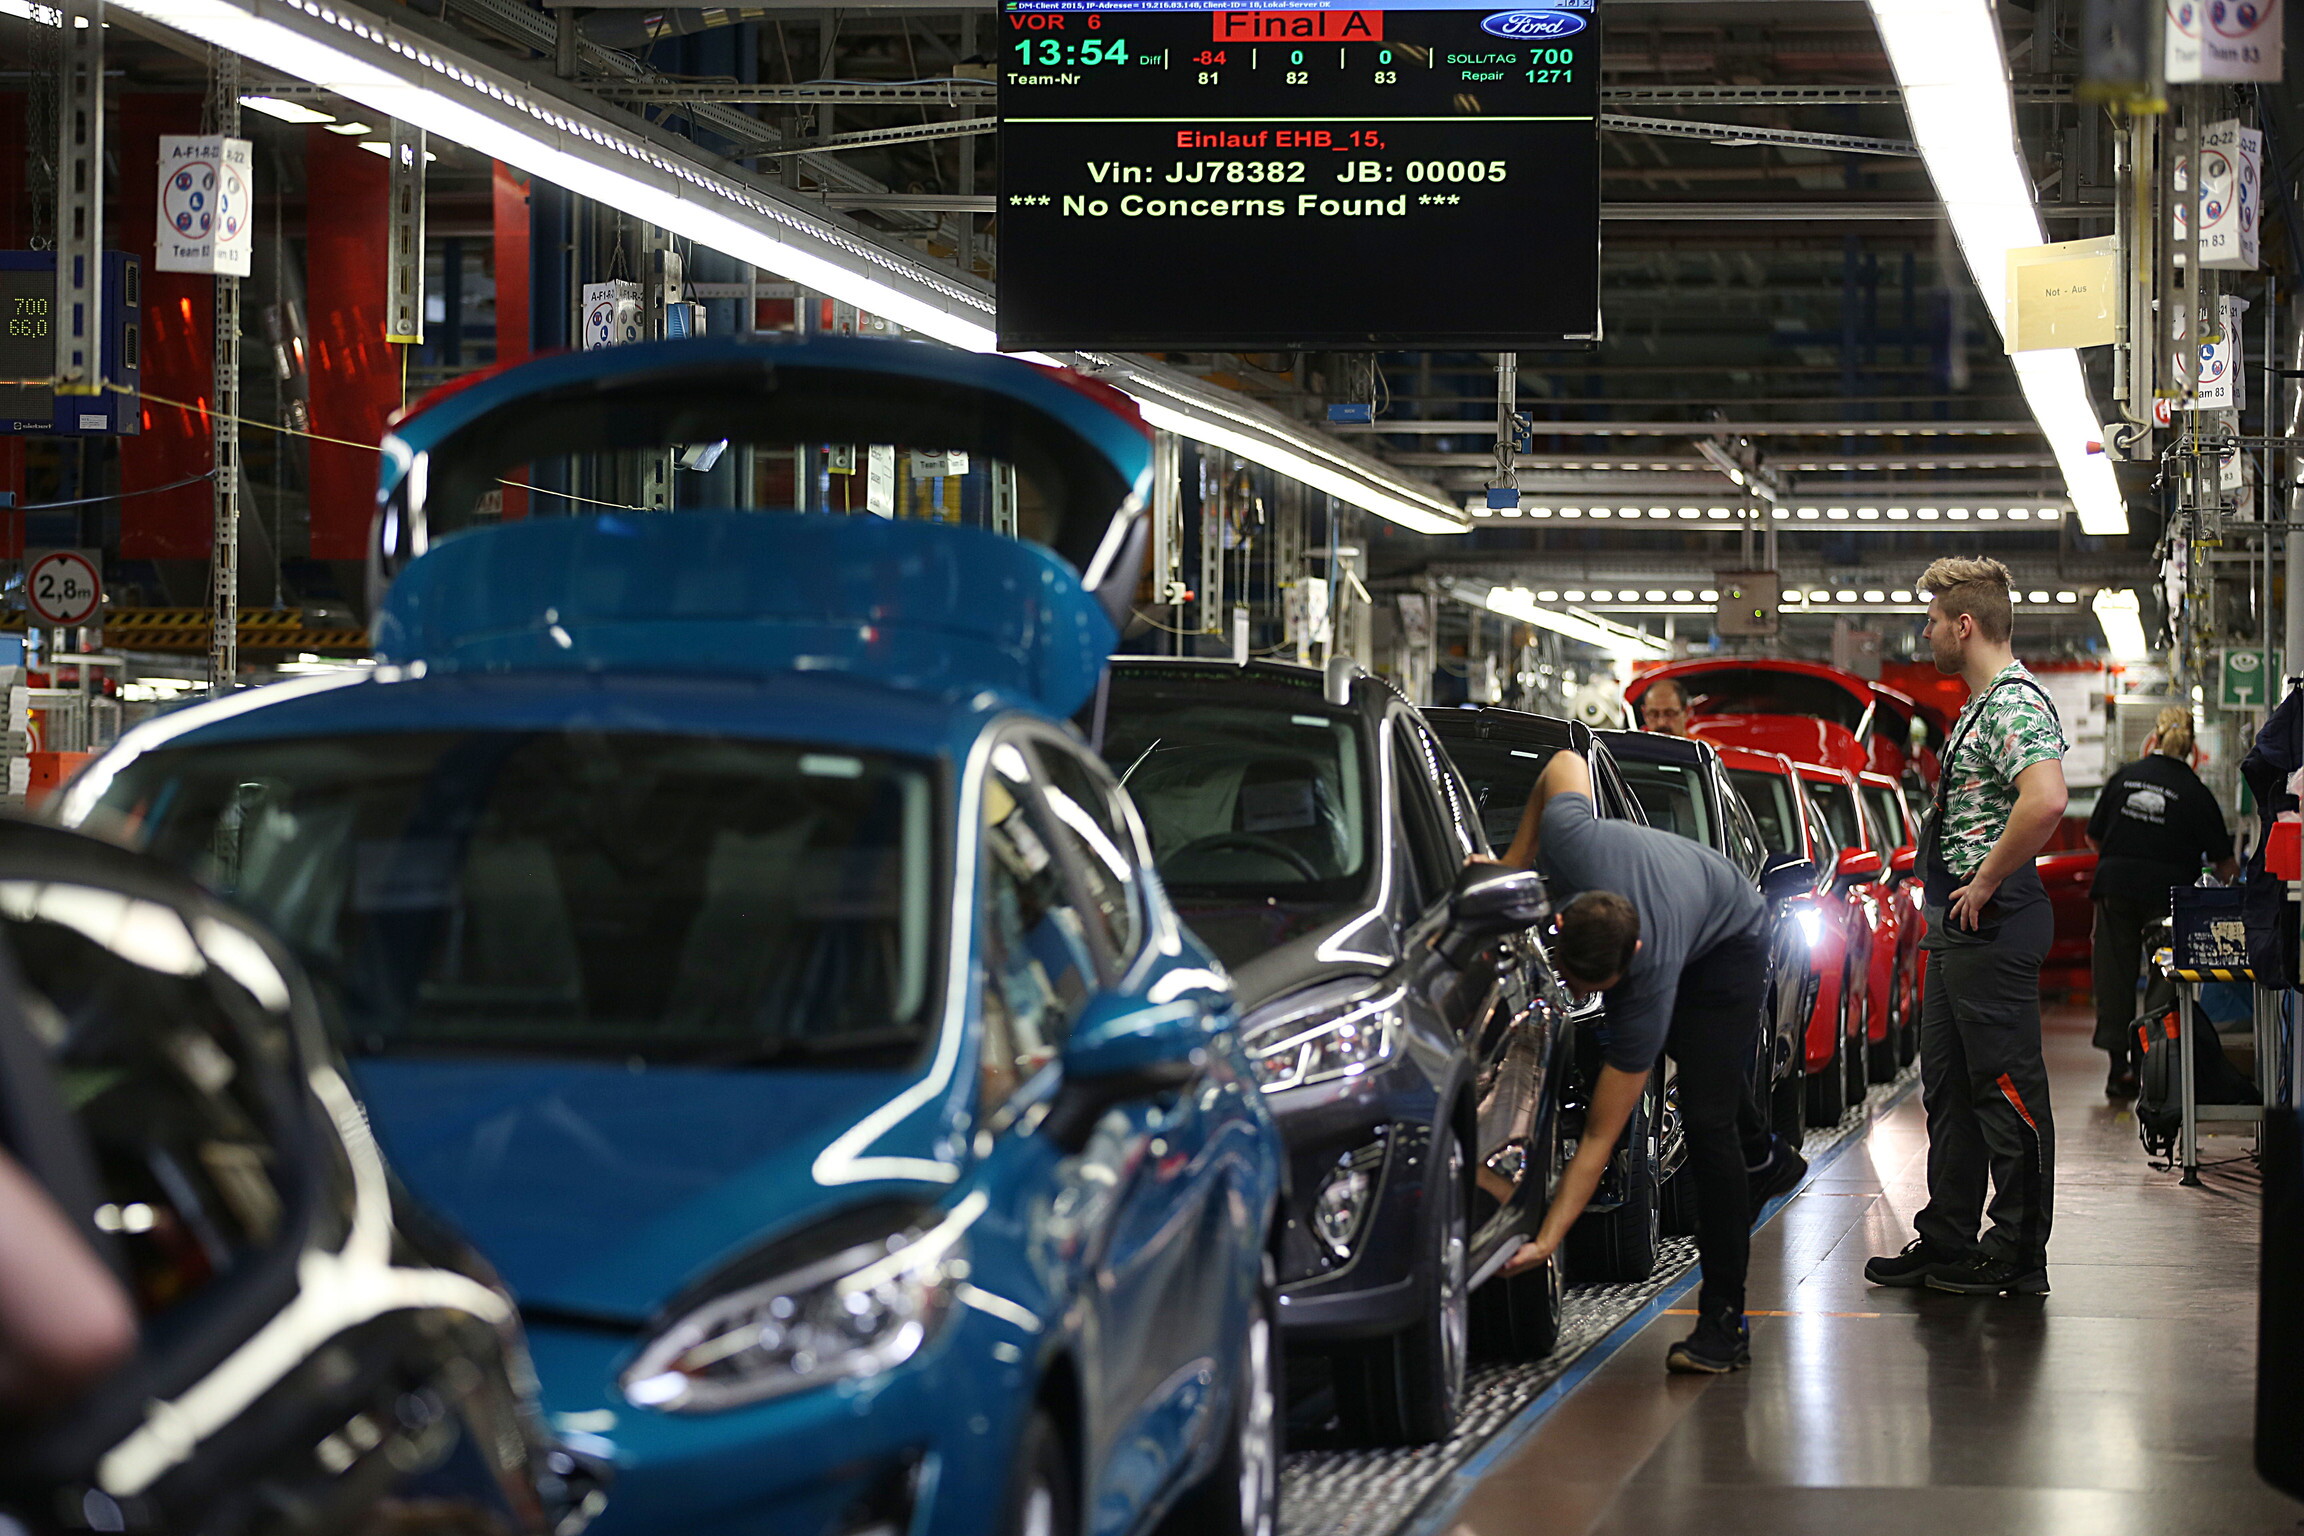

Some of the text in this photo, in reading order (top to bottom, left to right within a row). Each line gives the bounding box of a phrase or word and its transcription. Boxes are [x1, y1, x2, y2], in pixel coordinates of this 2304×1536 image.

[1061, 2, 1084, 10] 2015,
[1009, 14, 1101, 30] VOR 6
[1225, 11, 1371, 37] Final A
[1502, 13, 1565, 34] Ford
[1015, 38, 1129, 66] 13:54
[1139, 49, 1392, 65] Diff -84 0 0
[1446, 48, 1574, 65] SOLL/TAG 700
[1007, 71, 1397, 86] Team-Nr 81 82 83
[1461, 69, 1573, 84] Repair 1271
[1176, 130, 1386, 151] Einlauf EHB_15,
[1087, 161, 1507, 183] Vin: JJ78382 JB: 00005
[1062, 195, 1109, 217] No
[1120, 194, 1285, 217] Concerns
[1298, 194, 1406, 217] Found
[2212, 234, 2225, 246] 83
[173, 245, 199, 257] Team
[2045, 288, 2060, 297] Not
[2071, 285, 2087, 294] Aus
[14, 298, 47, 315] 700
[10, 319, 47, 338] 66,0
[2198, 390, 2212, 398] am
[2214, 387, 2225, 397] 83
[38, 574, 91, 604] 2,8m
